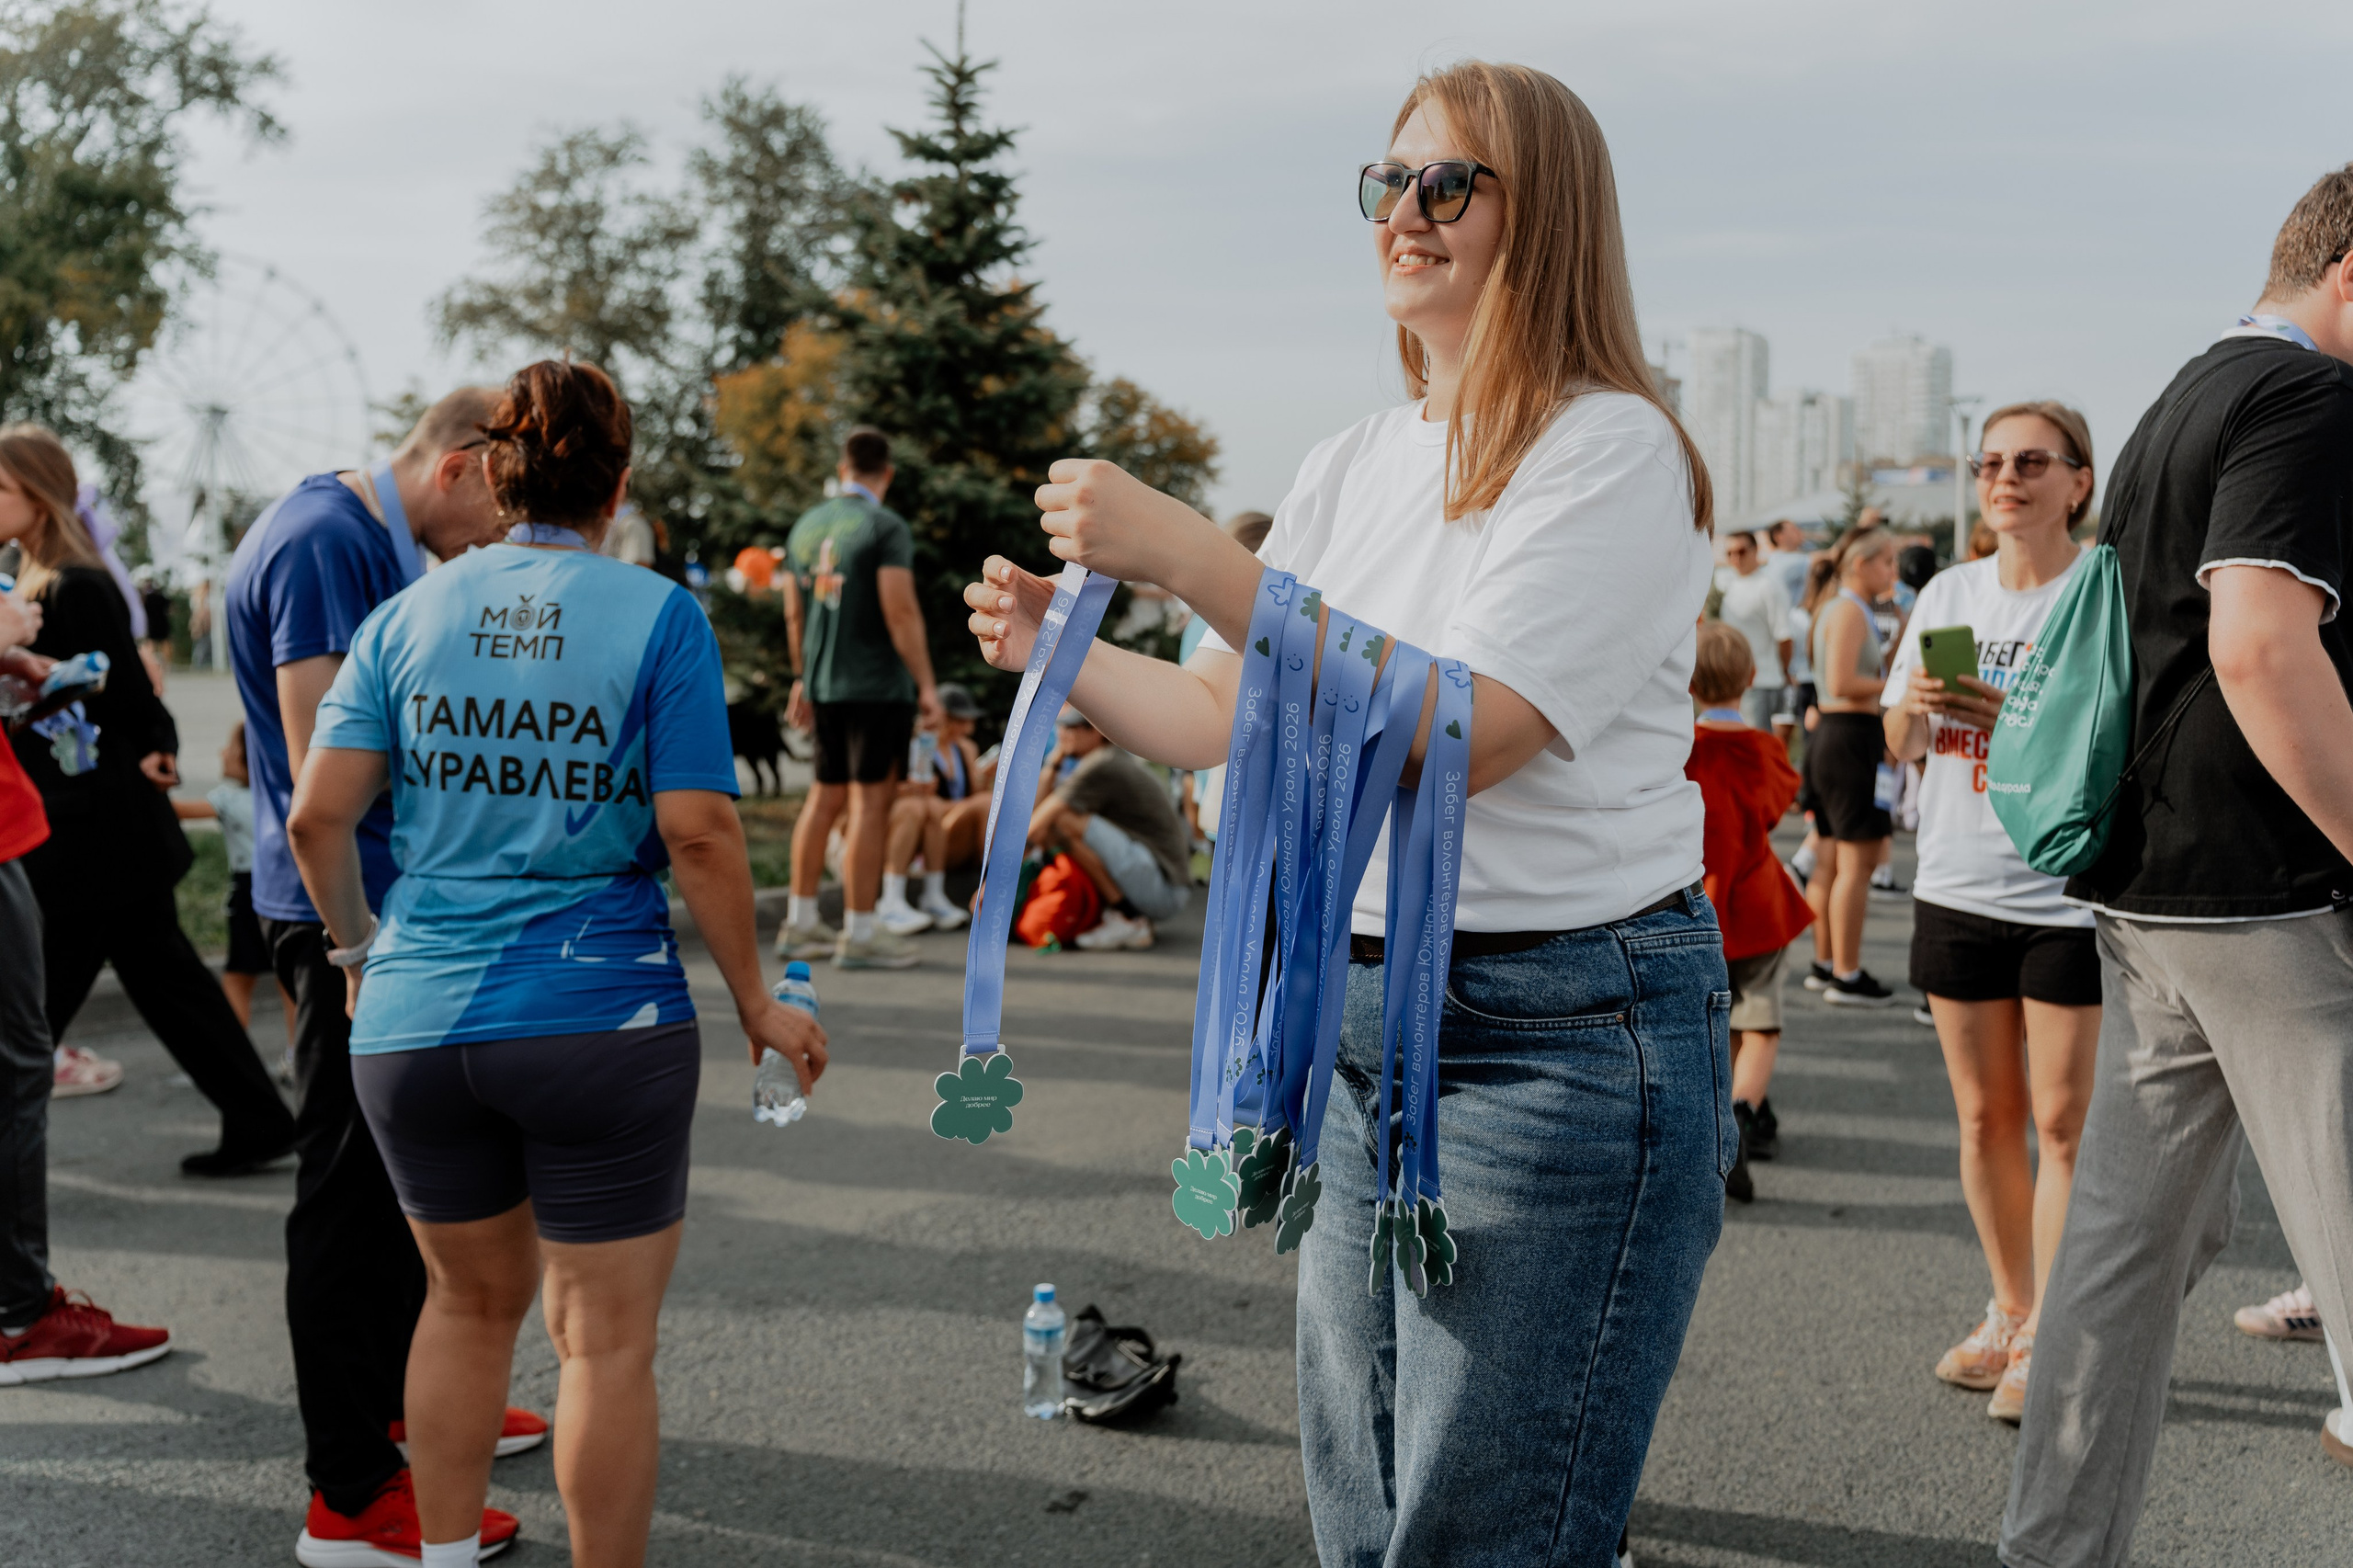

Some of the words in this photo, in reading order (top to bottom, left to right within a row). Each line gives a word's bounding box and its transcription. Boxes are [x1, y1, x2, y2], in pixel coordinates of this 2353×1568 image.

[479, 595, 563, 631] МОЙ
[470, 632, 563, 661] ТЕМП
[998, 708, 1024, 783] Южного
[1020, 647, 1047, 701] Урала
[1041, 596, 1069, 642] 2026
[1242, 687, 1263, 743] Забег
[413, 694, 608, 747] ТАМАРА
[1284, 702, 1300, 752] 2026
[1935, 727, 1989, 760] ВМЕС
[1282, 756, 1297, 813] Урала
[1316, 734, 1332, 782] 2026
[1334, 743, 1352, 792] 2026
[1228, 747, 1246, 857] волонтёров
[1328, 796, 1344, 853] Урала
[1444, 771, 1461, 824] Забег
[1280, 820, 1293, 894] Южного
[1438, 830, 1454, 934] волонтёров
[1322, 858, 1336, 932] Южного
[1437, 937, 1449, 1010] Южного
[1234, 1001, 1249, 1047] 2026
[1412, 971, 1431, 1073] волонтёров
[1406, 1075, 1420, 1126] Забег
